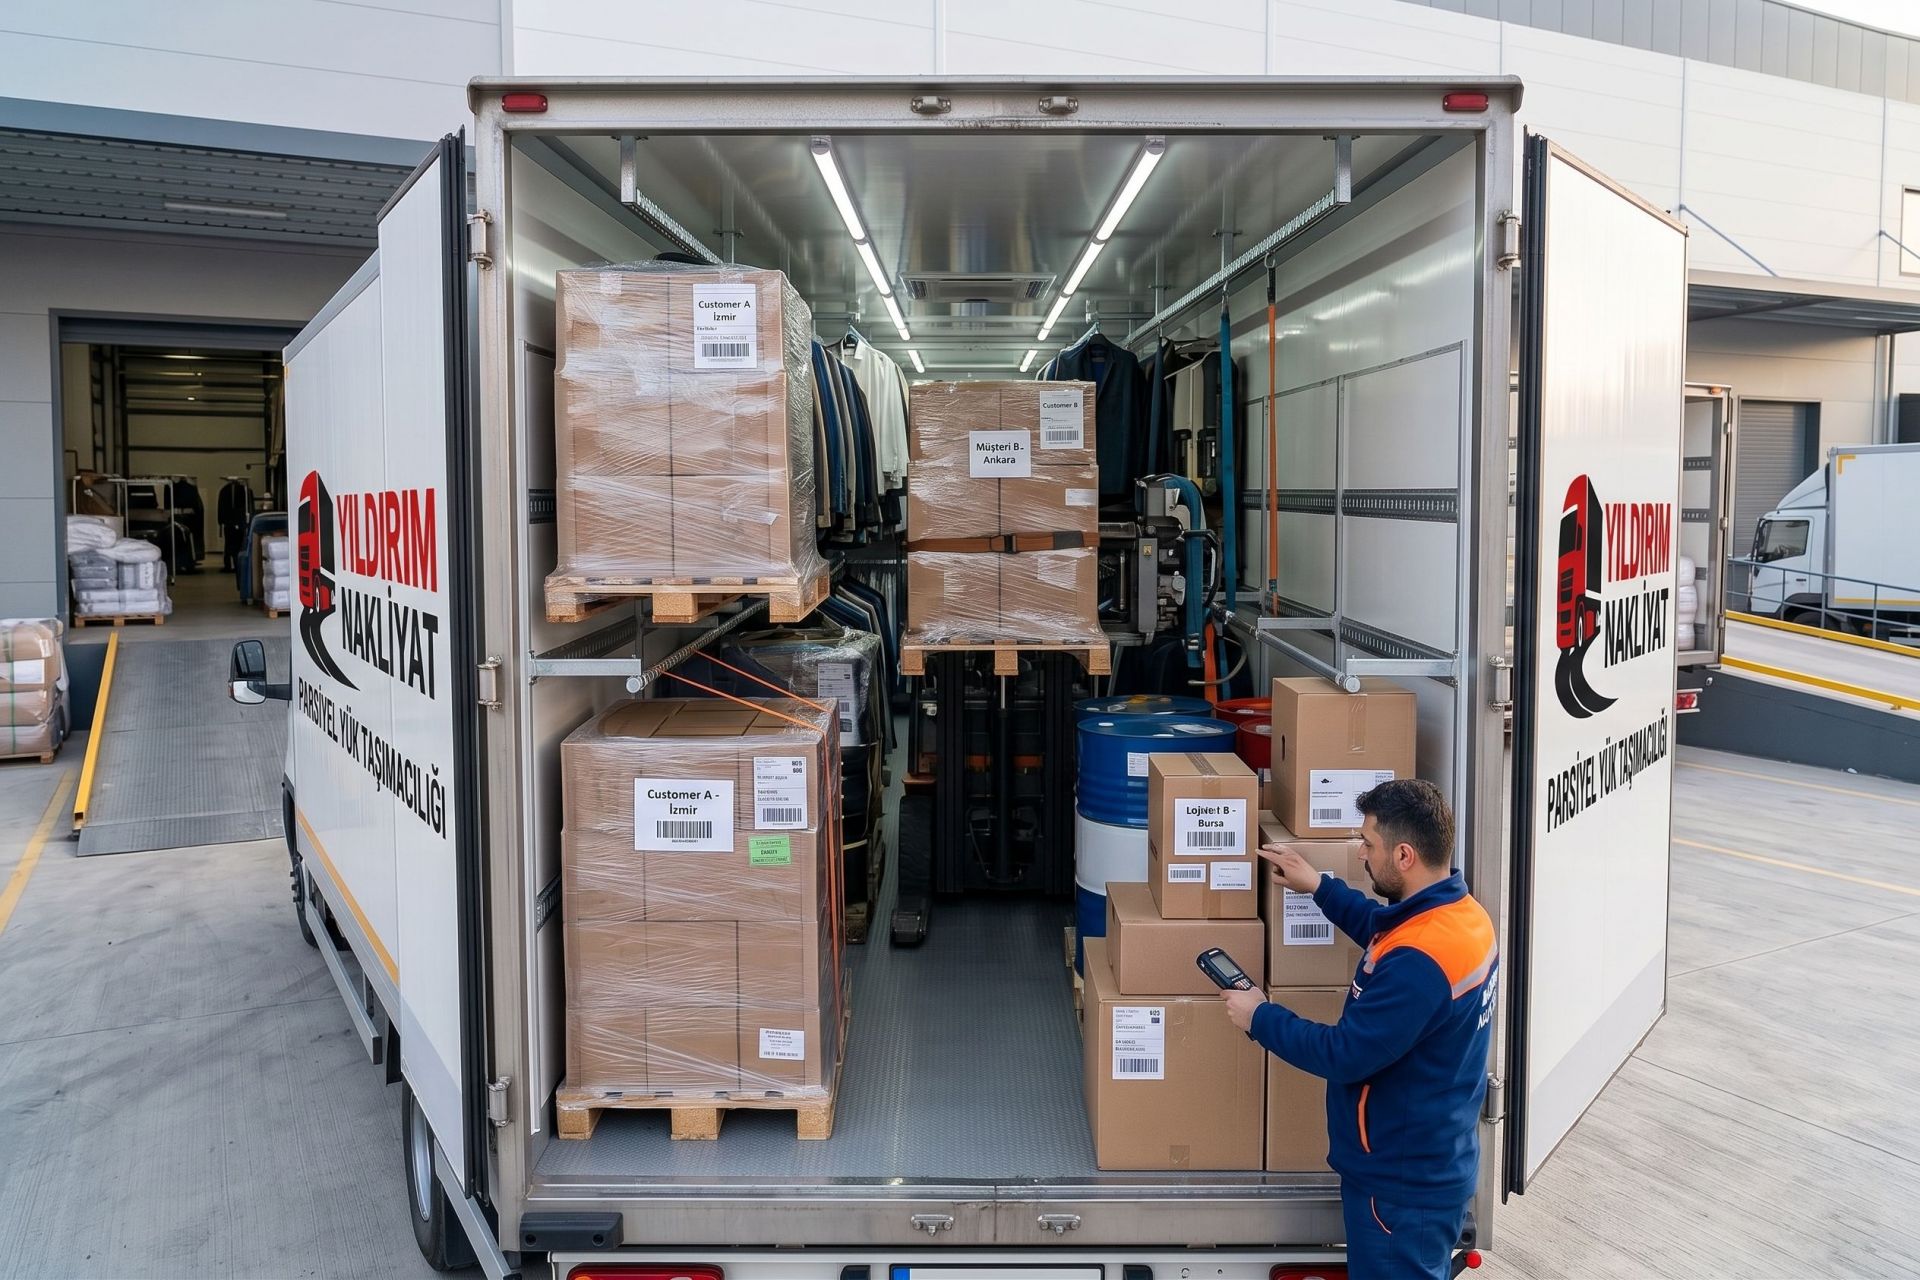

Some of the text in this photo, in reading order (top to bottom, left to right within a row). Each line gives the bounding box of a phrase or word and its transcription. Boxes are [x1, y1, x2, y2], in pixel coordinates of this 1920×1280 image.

[698, 300, 741, 309] Customer
[976, 442, 1011, 453] Müşteri
[983, 456, 1016, 465] Ankara
[336, 488, 437, 593] YILDIRIM
[1605, 503, 1671, 583] YILDIRIM
[341, 585, 438, 700] NAKLİYAT
[1604, 579, 1669, 668] NAKLİYAT
[298, 676, 446, 840] PARSİYEL YÜK TAŞIMACILIĞI
[1547, 707, 1667, 833] PARSİYEL YÜK TAŞIMACILIĞI
[647, 789, 701, 800] Customer
[704, 790, 712, 800] A
[1223, 806, 1230, 814] B
[1198, 819, 1224, 828] Bursa
